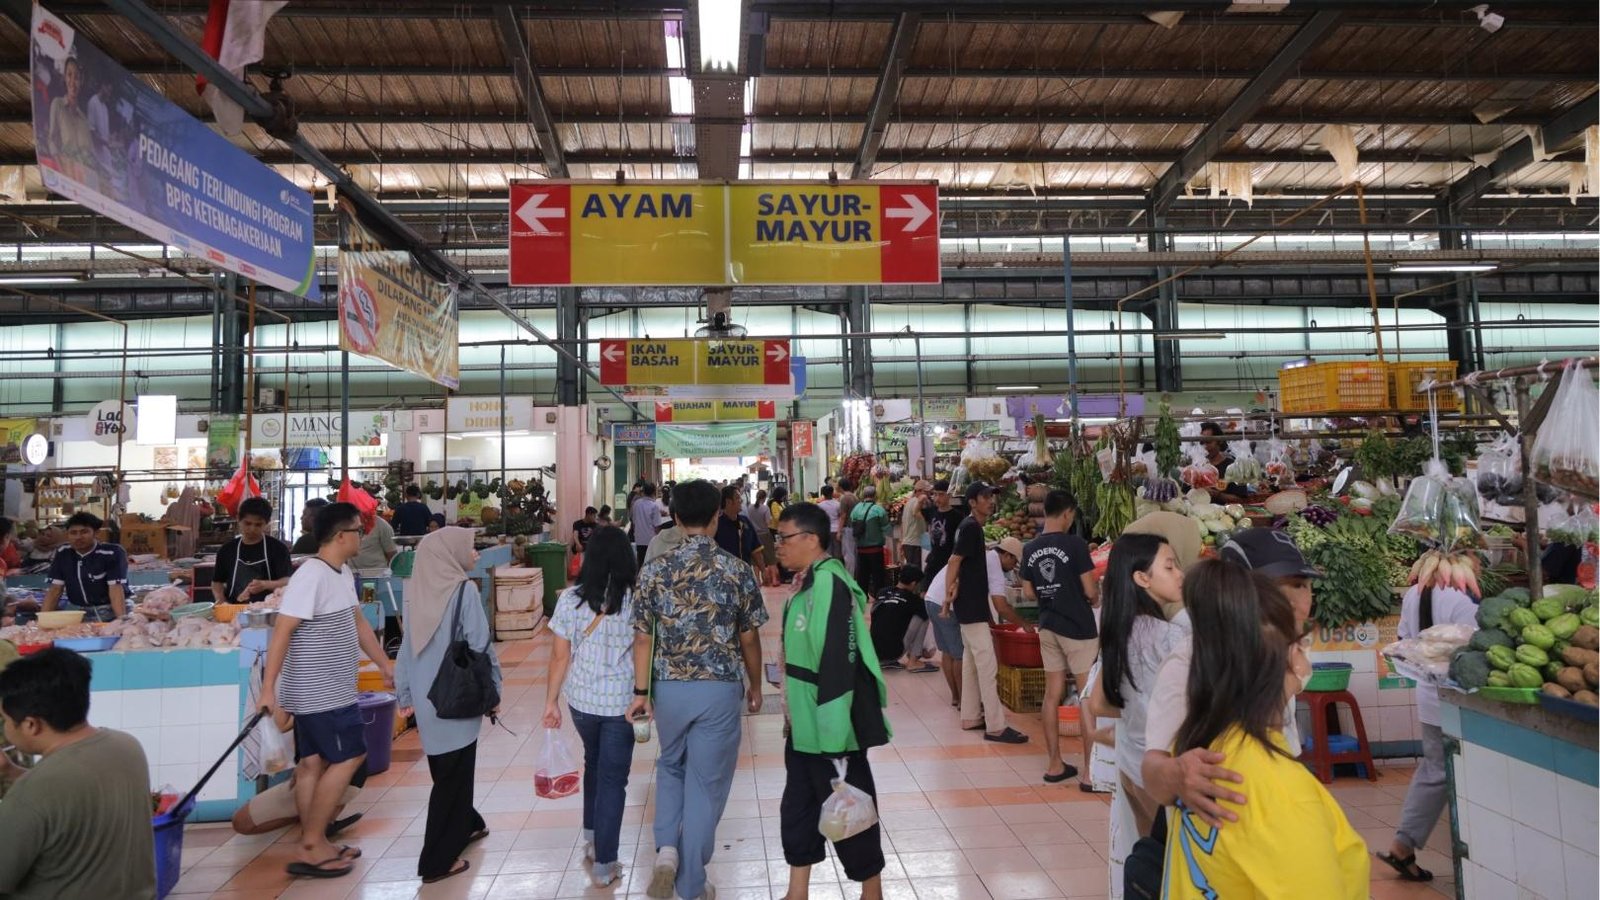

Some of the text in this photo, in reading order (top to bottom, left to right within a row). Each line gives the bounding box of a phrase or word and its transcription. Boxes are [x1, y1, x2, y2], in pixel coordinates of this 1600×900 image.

[139, 133, 199, 190] PEDAGANG
[201, 171, 261, 222] TERLINDUNGI
[262, 205, 304, 243] PROGRAM
[581, 193, 693, 219] AYAM
[758, 194, 872, 216] SAYUR-
[165, 182, 192, 217] BPJS
[194, 199, 282, 259] KETENAGAKERJAAN
[756, 220, 872, 242] MAYUR
[377, 279, 422, 316] DILARANG
[631, 344, 666, 355] IKAN
[631, 355, 679, 366] BASAH
[707, 355, 760, 366] MAYUR
[673, 401, 712, 410] BUAHAN
[722, 400, 757, 409] MAYUR
[1027, 546, 1070, 568] TENDENCIES
